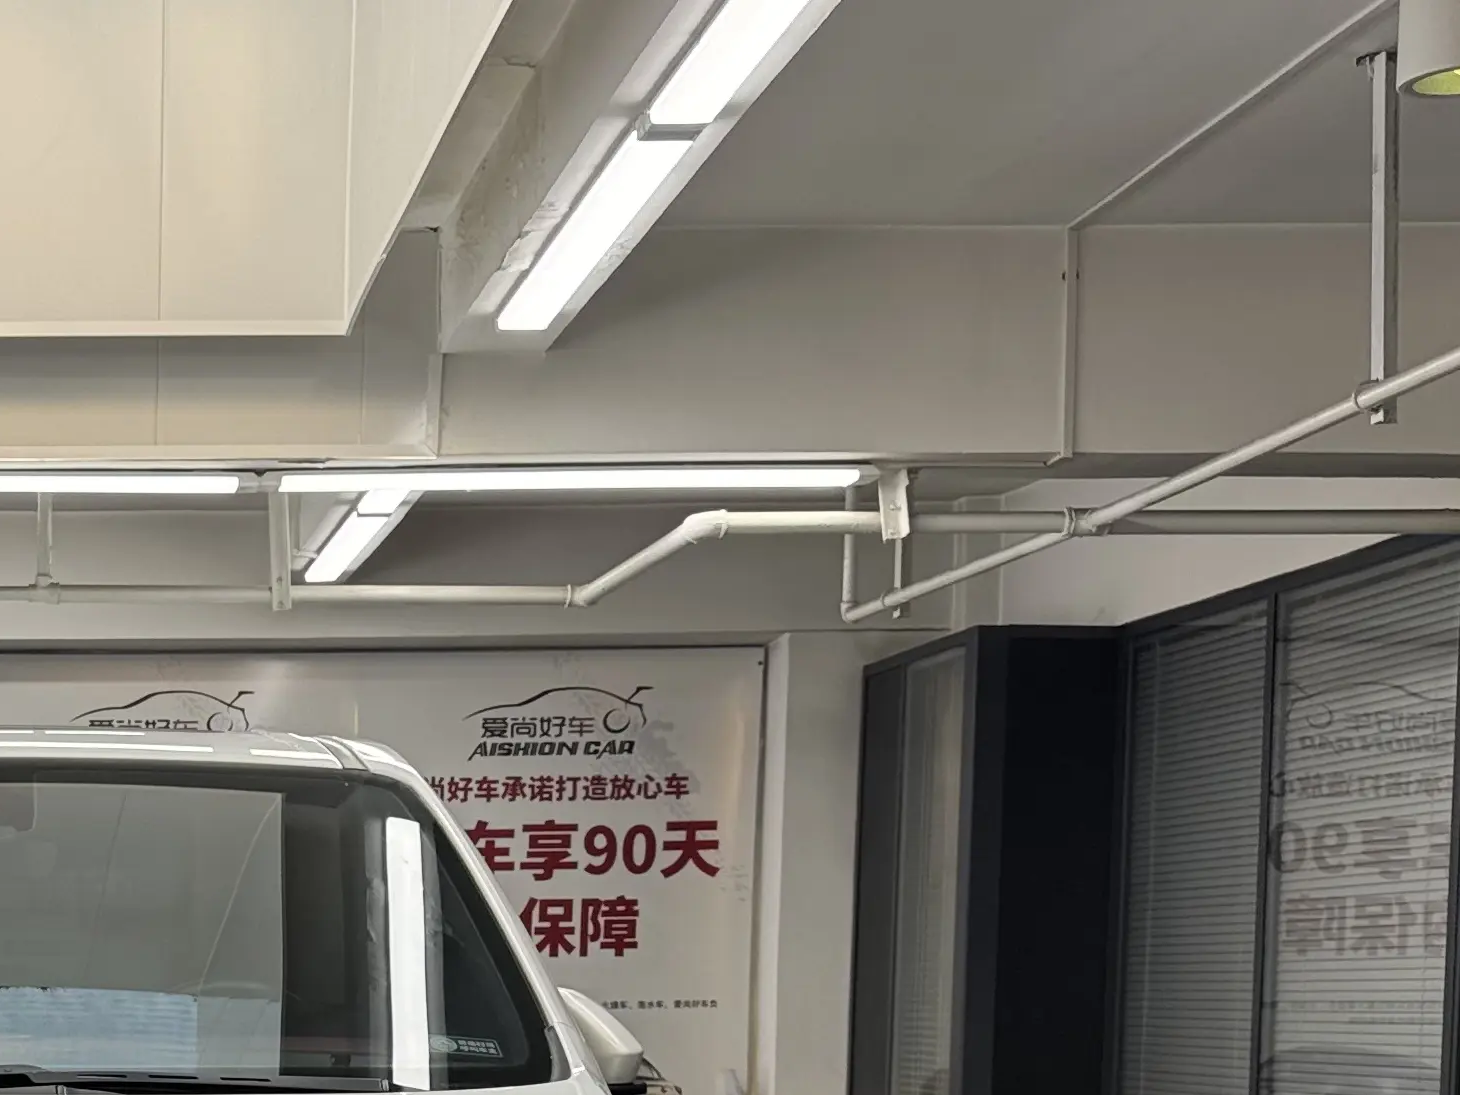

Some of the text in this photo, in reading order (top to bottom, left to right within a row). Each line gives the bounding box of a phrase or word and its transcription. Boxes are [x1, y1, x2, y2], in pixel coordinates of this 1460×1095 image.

[481, 716, 596, 738] 爱尚好车
[467, 739, 636, 761] AISHION CAR
[519, 894, 640, 957] 保障
